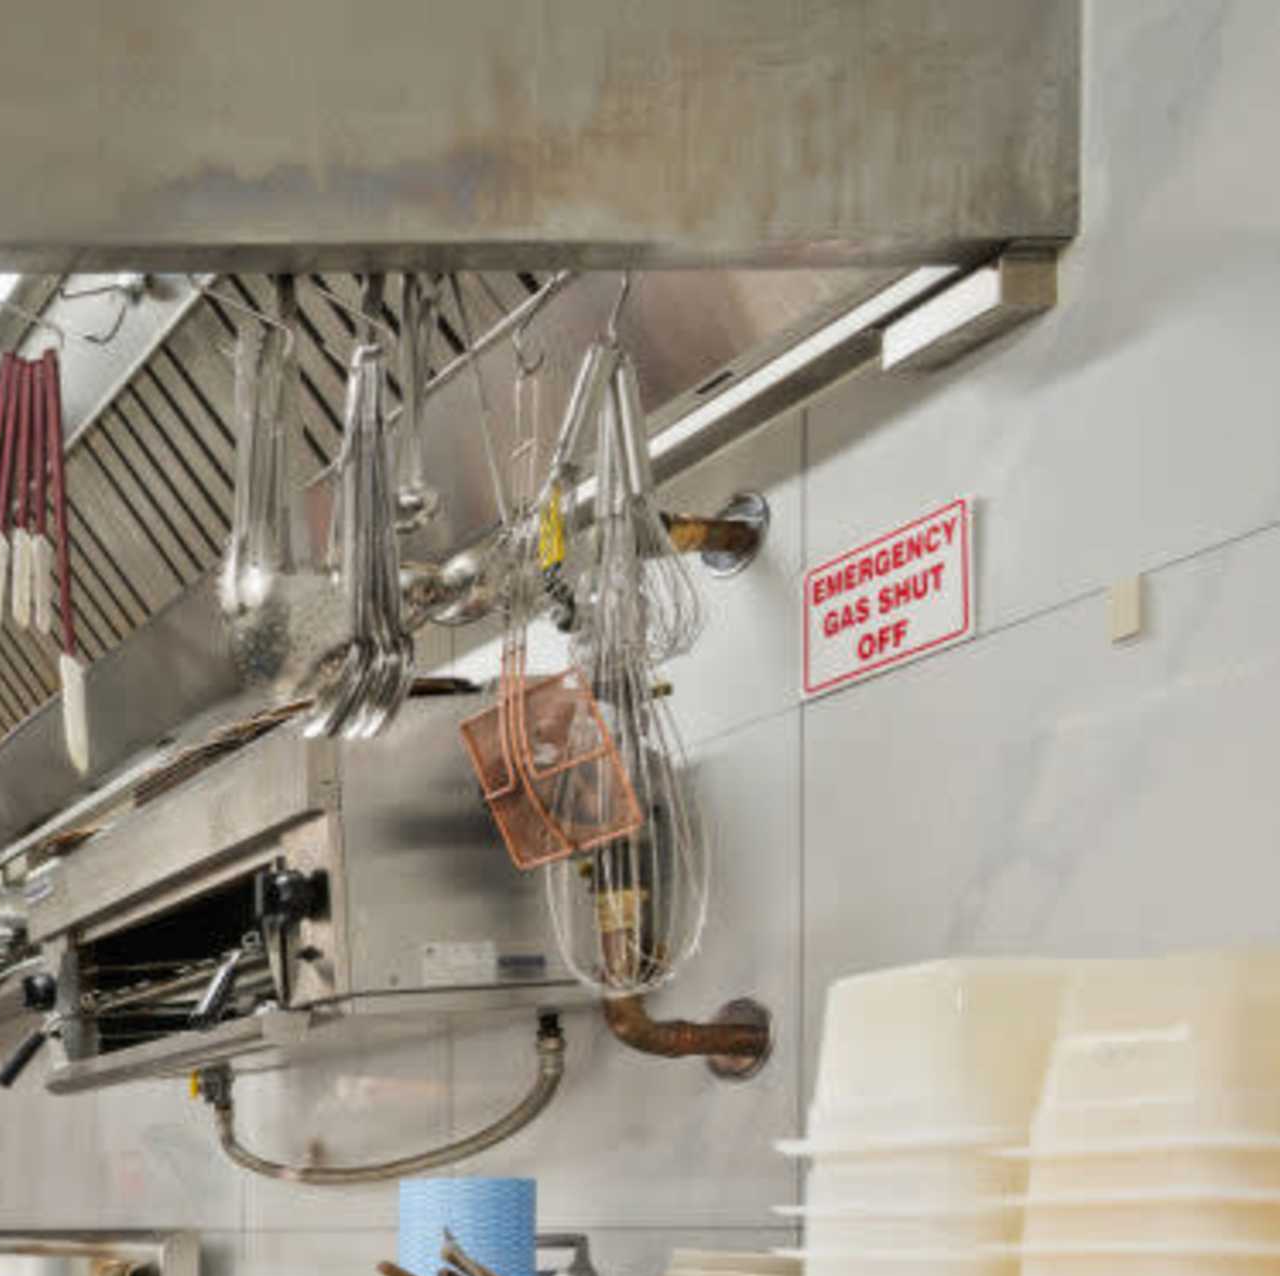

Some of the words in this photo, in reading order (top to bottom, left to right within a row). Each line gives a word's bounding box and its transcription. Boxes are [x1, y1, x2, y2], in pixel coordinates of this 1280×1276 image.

[813, 517, 957, 605] EMERGENCY
[823, 597, 870, 638] GAS
[878, 561, 945, 615] SHUT
[857, 618, 909, 660] OFF
